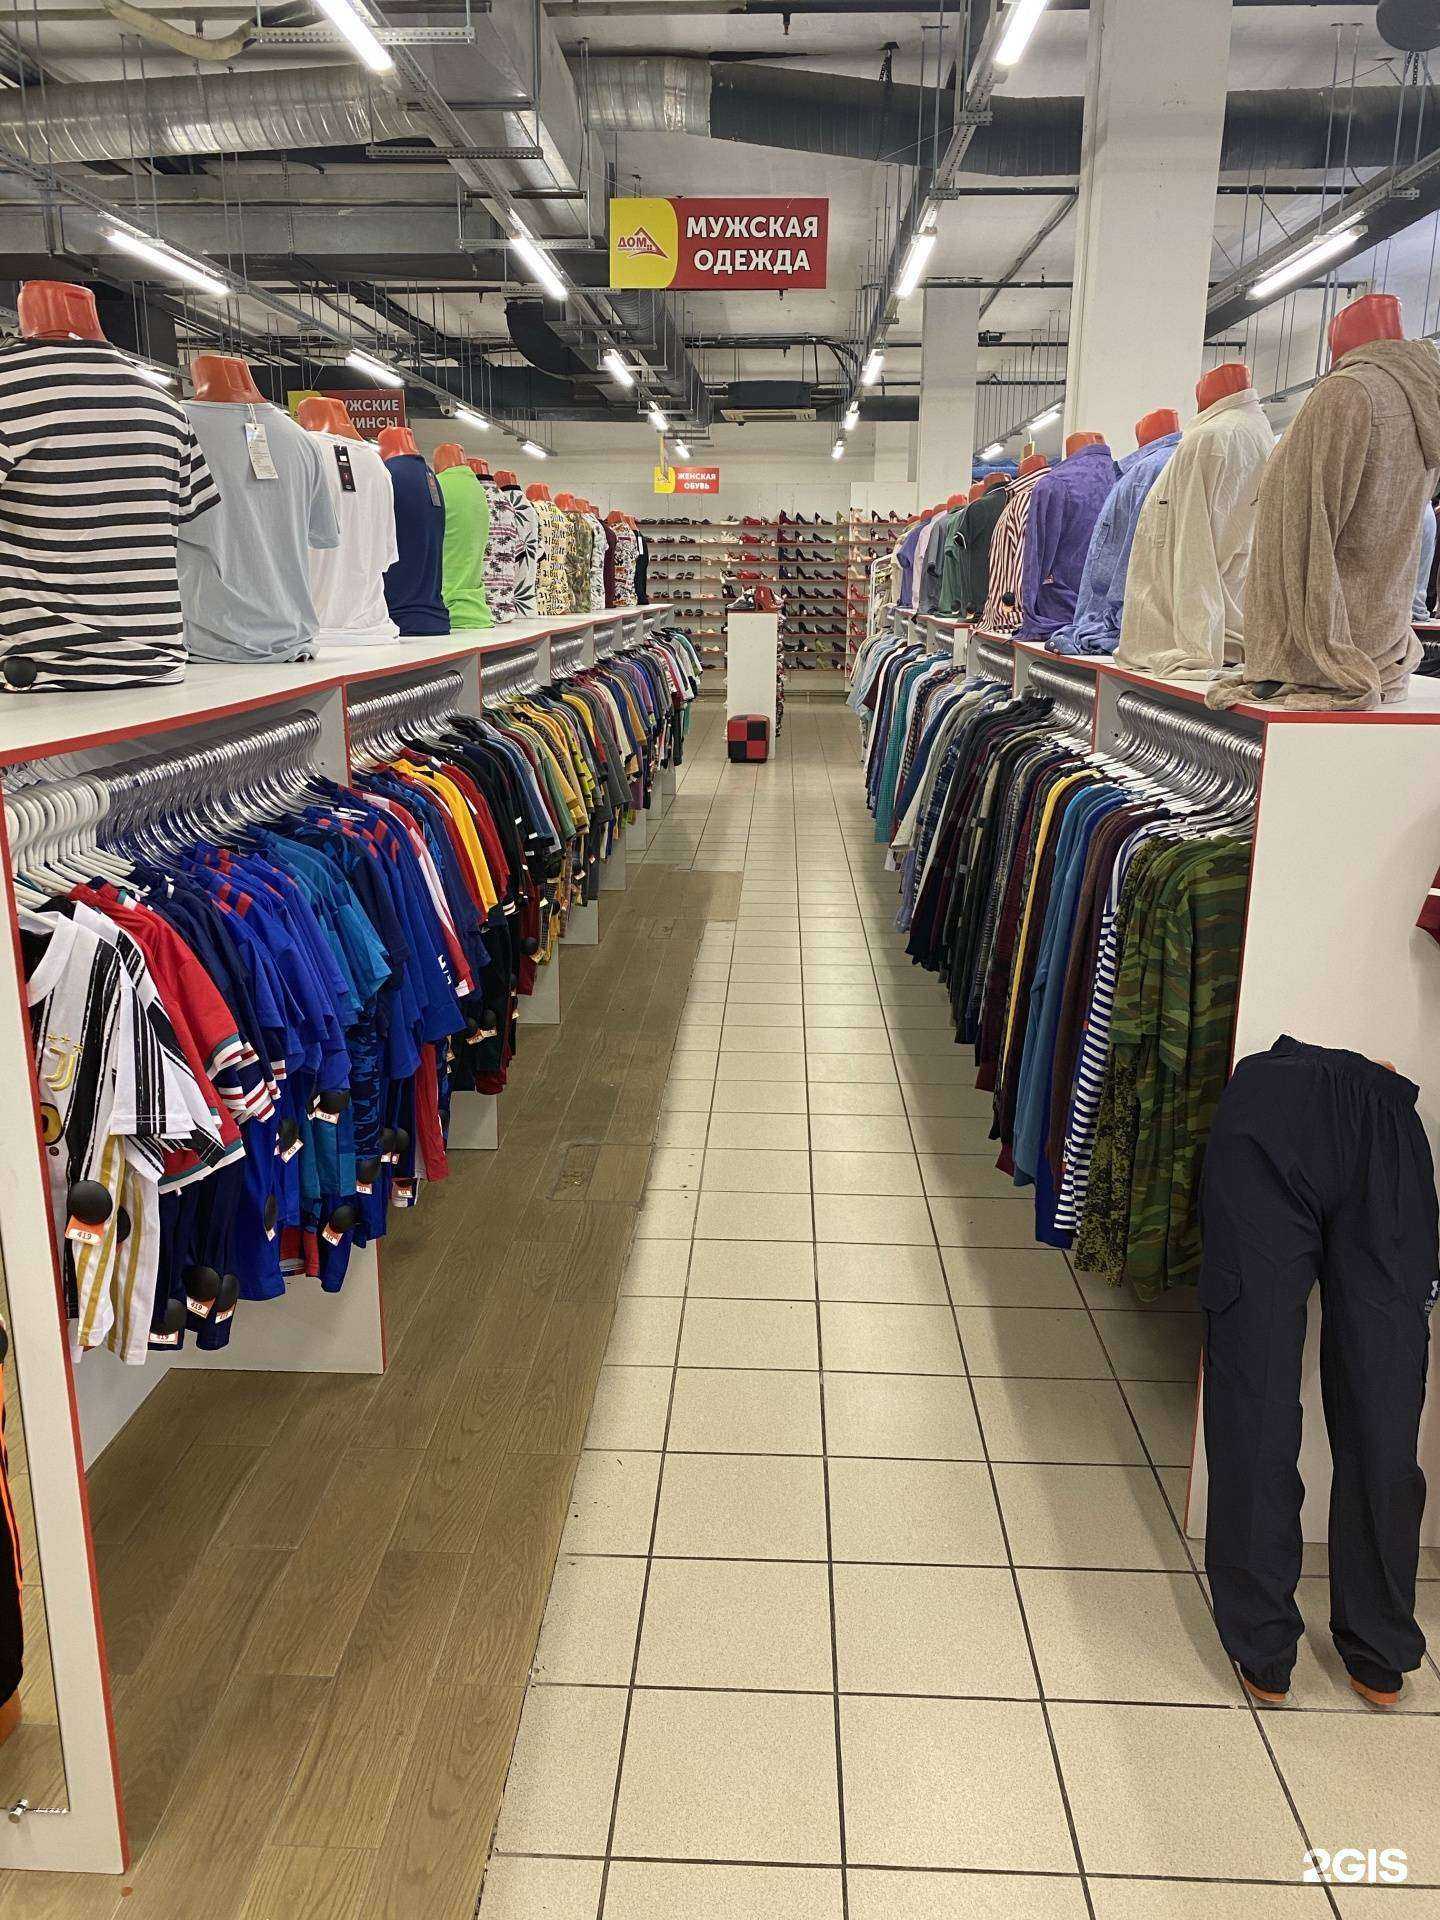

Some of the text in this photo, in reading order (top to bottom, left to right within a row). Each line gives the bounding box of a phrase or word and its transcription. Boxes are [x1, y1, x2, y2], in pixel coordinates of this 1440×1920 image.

[686, 216, 818, 238] МУЖСКАЯ
[694, 250, 811, 274] ОДЕЖДА
[677, 472, 717, 480] ЖЕНСКАЯ
[683, 482, 710, 490] ОБУВЬ
[76, 1231, 92, 1241] 419
[190, 1302, 203, 1312] 419
